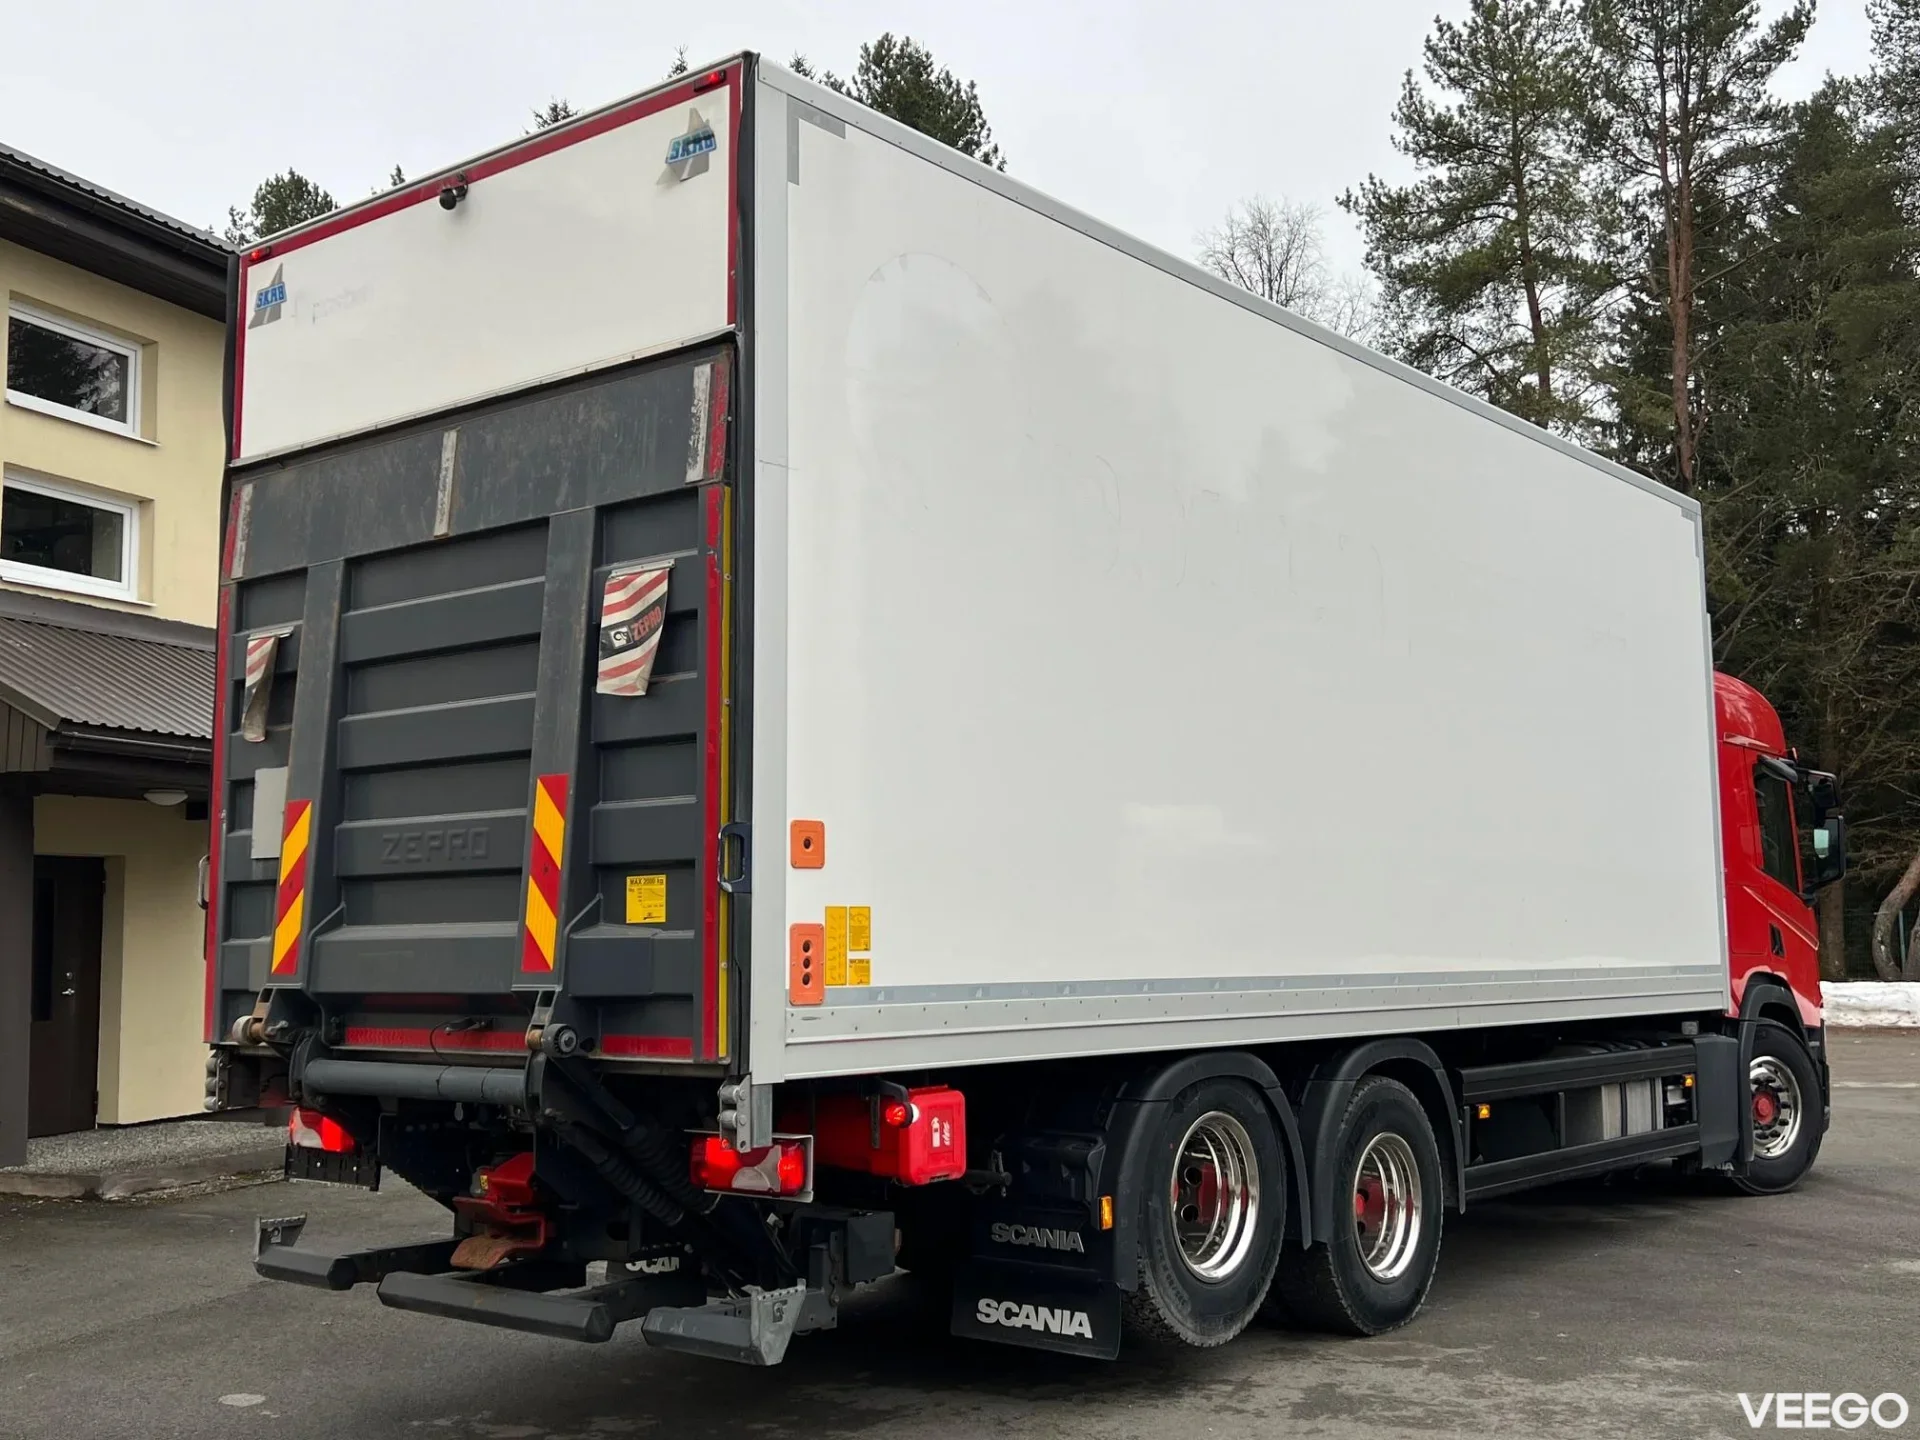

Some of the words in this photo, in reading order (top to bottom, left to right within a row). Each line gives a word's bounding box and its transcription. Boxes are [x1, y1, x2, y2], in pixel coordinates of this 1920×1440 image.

[256, 285, 285, 308] SKAB
[631, 606, 662, 641] ZEPRO
[381, 827, 490, 863] ZEPRO
[991, 1222, 1084, 1253] SCANIA
[976, 1298, 1093, 1339] SCANIA
